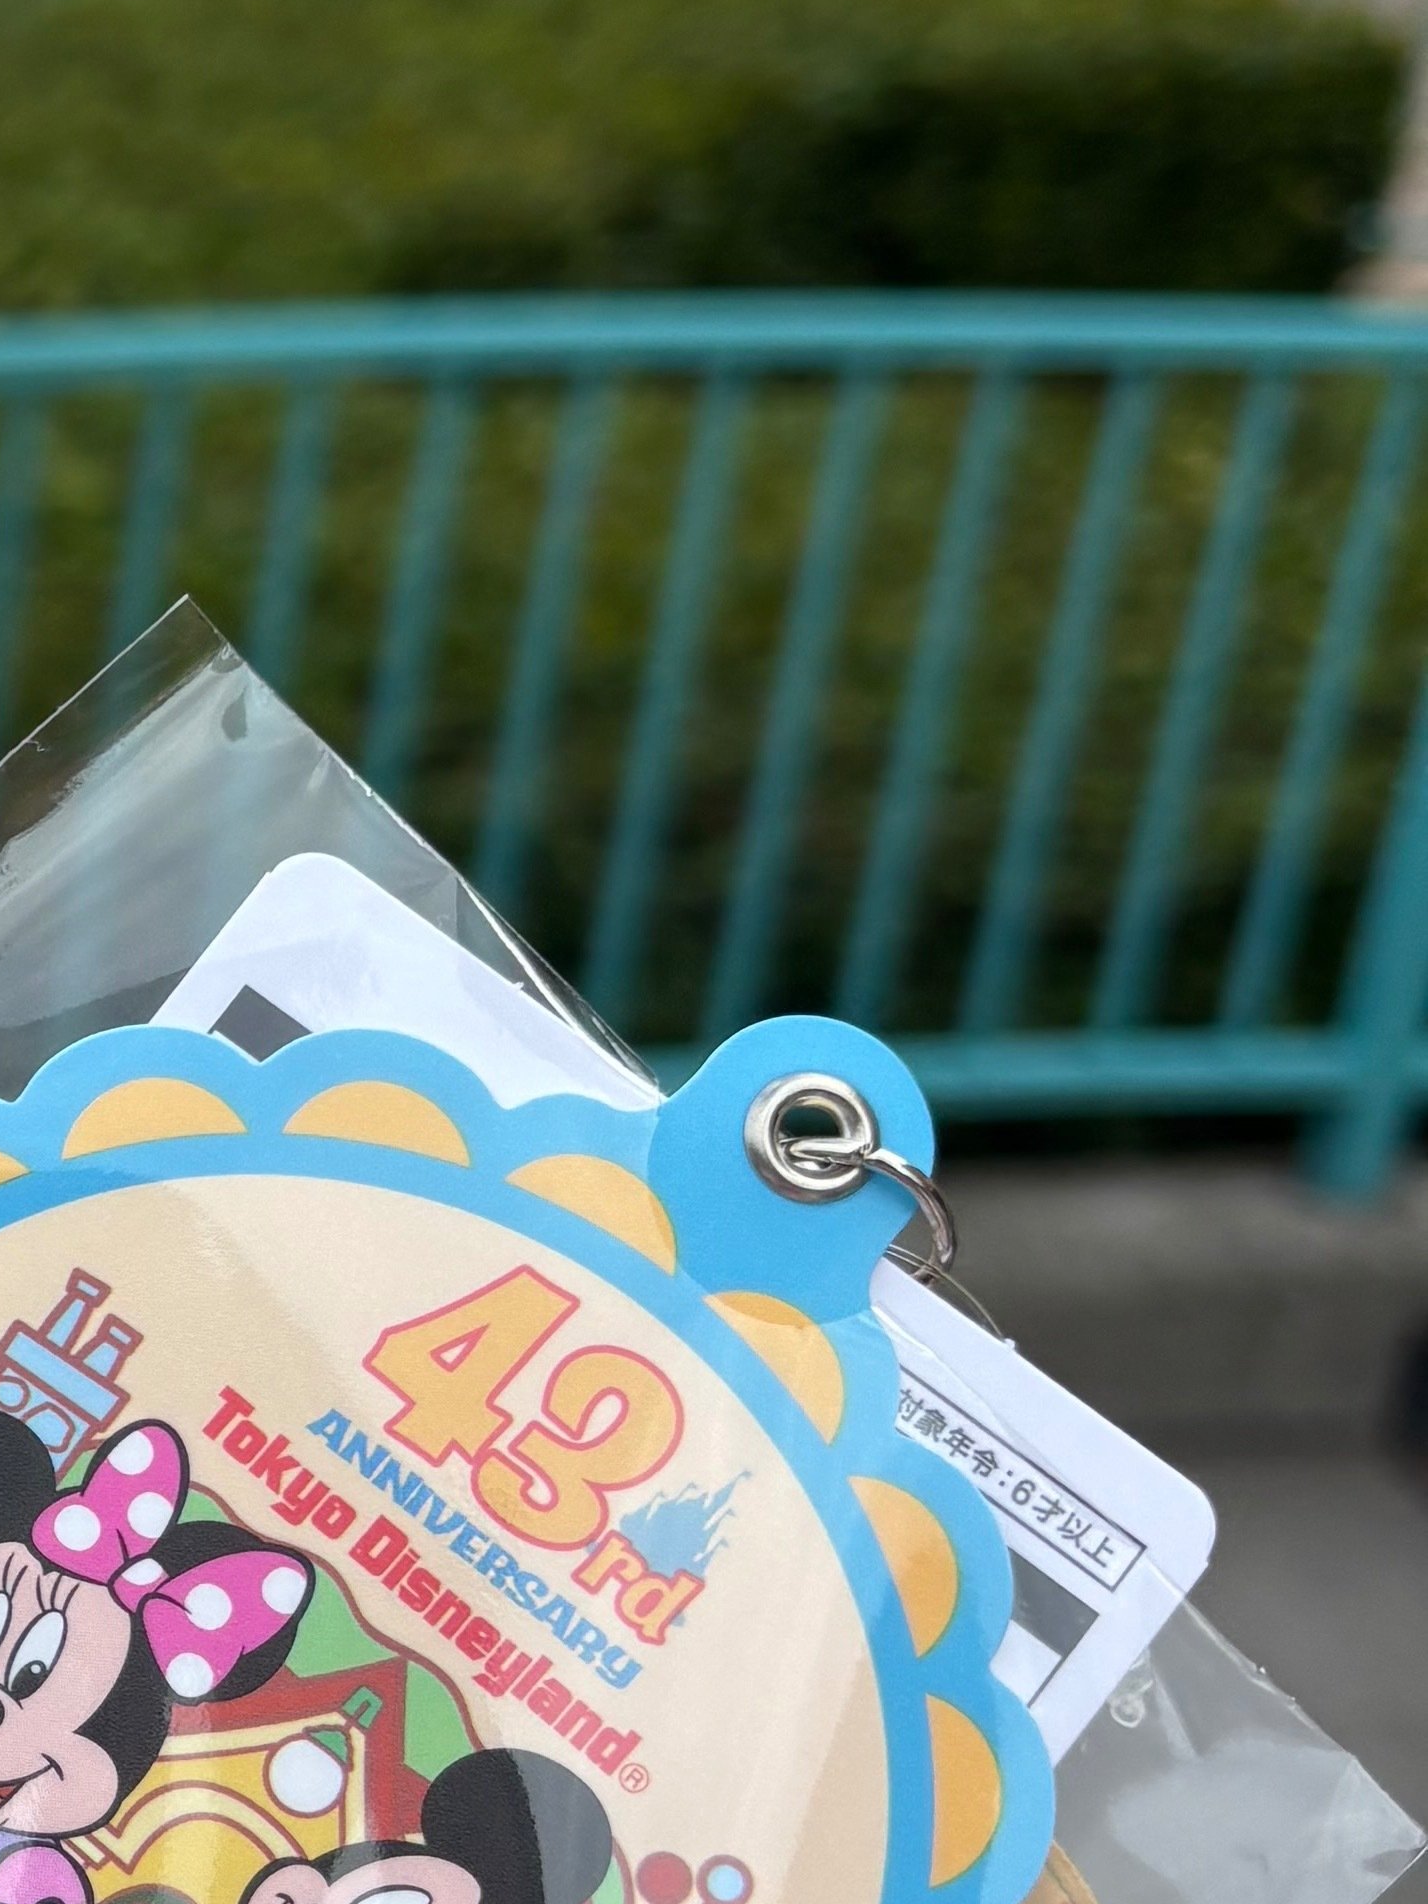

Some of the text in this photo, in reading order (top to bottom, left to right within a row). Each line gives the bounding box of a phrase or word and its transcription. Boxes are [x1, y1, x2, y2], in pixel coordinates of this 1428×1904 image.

[200, 1385, 354, 1542] Tokyo
[306, 1408, 641, 1691] ANNIVERSARY
[362, 1265, 705, 1646] 43rd
